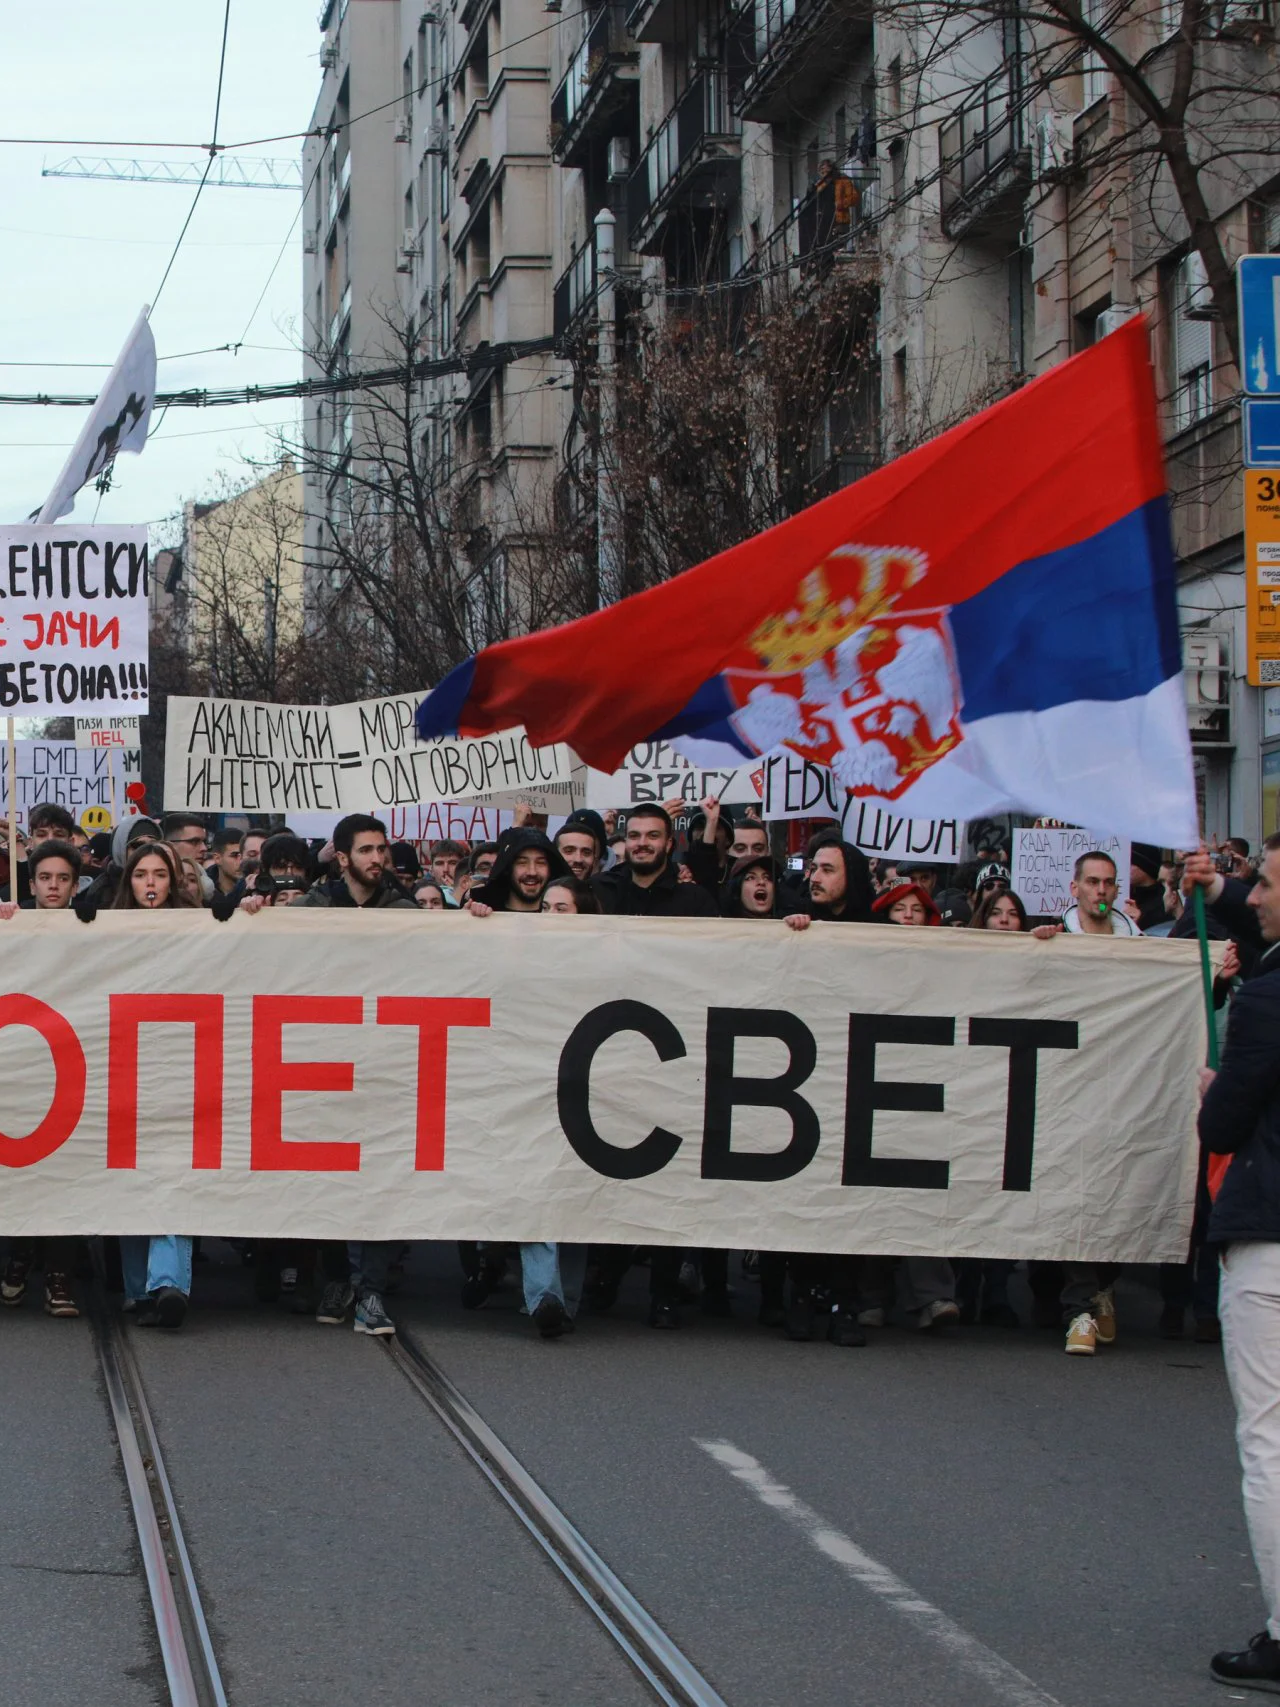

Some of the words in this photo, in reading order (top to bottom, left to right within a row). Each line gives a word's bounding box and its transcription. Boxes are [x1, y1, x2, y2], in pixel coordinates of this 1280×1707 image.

[23, 611, 119, 650] ЈАЧИ
[77, 718, 103, 730] ПАЗИ
[110, 717, 138, 729] ПРСТЕ
[188, 702, 334, 759] АКАДЕМСКИ
[91, 731, 124, 746] ПЕЦ
[33, 747, 77, 774] СМО
[186, 757, 341, 810] ИНТЕГРИТЕТ
[630, 769, 738, 803] ВРАГУ
[1020, 832, 1051, 852] КАДА
[1018, 855, 1071, 872] ПОСТАНЕ
[1018, 877, 1064, 893] ПОБУНА
[557, 998, 1079, 1193] СВЕТ
